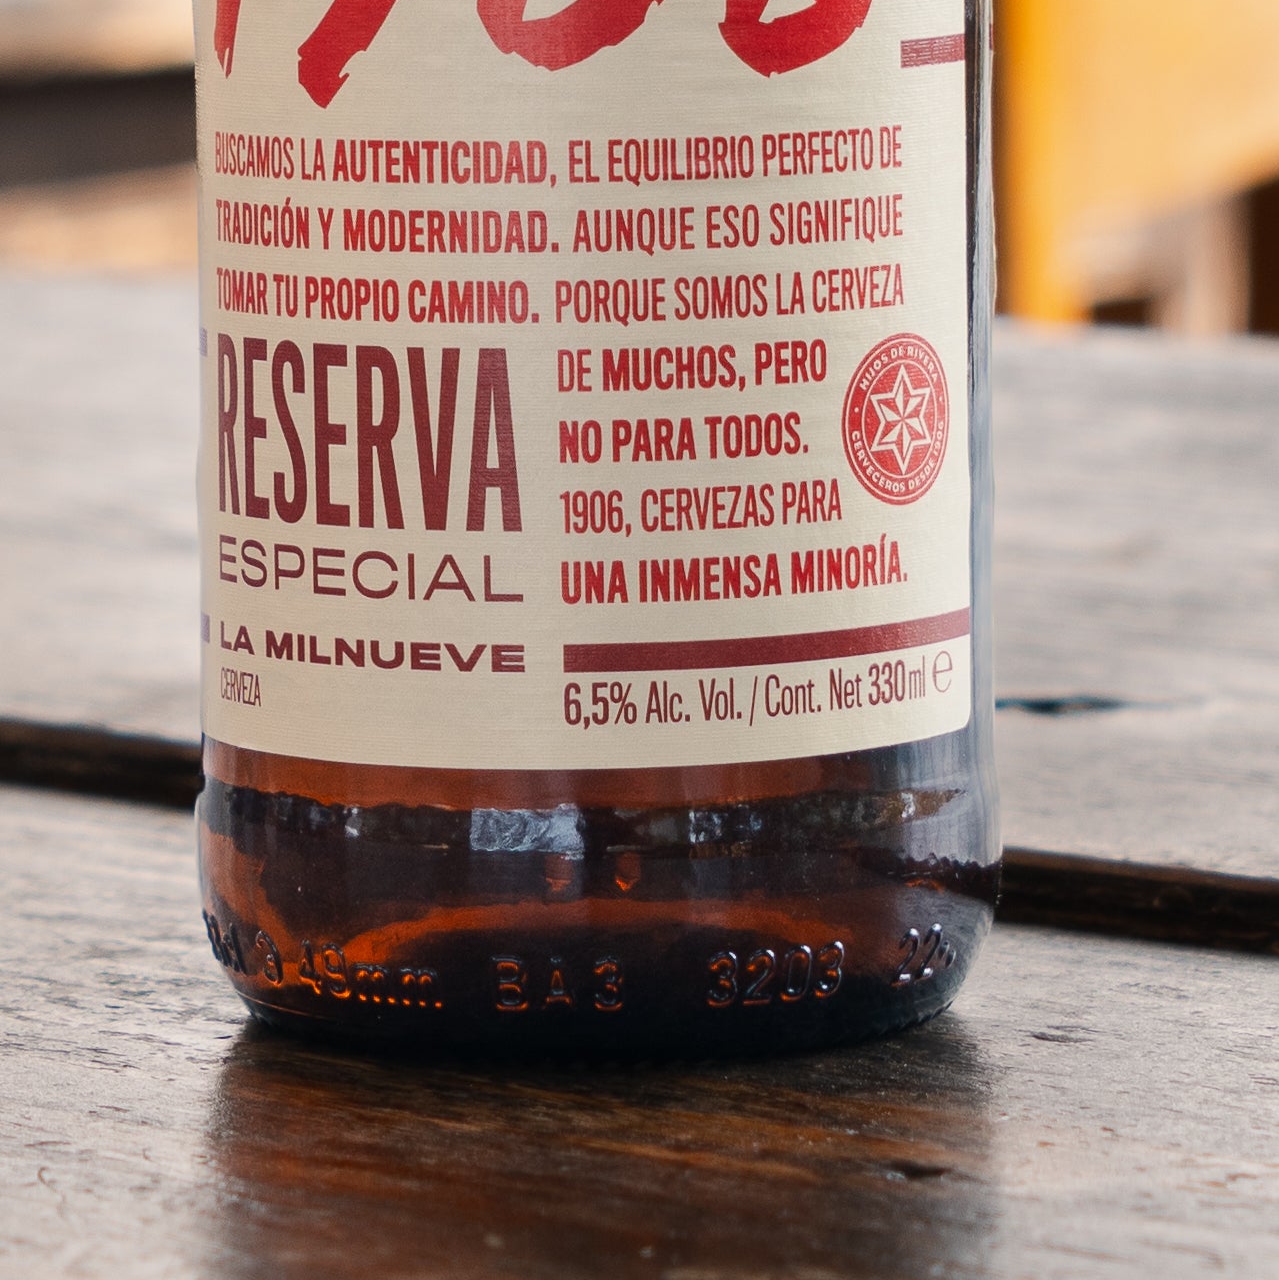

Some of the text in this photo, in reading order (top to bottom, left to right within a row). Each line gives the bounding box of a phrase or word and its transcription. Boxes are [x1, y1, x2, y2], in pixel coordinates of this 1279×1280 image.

[215, 125, 903, 186] BUSCAMOS LA AUTENTICIDAD, EL EQUILIBRIO PERFECTO DE
[216, 194, 903, 256] TRADICIÓN Y MODERNIDAD. AUNQUE ESO SIGNIFIQUE
[217, 264, 903, 327] TOMAR TU PROPIO CAMINO. PORQUE SOMOS LA CERVEZA
[557, 339, 827, 393] DE MUCHOS, PERO
[859, 353, 889, 391] HIJOS
[218, 332, 523, 531] RESERVA
[559, 411, 809, 464] NO PARA TODOS.
[851, 430, 905, 492] CERVECEROS
[908, 461, 935, 491] DESDE
[560, 478, 842, 536] 1906, CERVEZAS PARA
[220, 535, 524, 603] ESPECIAL
[561, 533, 907, 604] UNA INMENSA MINORÍA.
[220, 620, 525, 673] LA MILNUEVE
[220, 666, 263, 707] CERVEZA
[563, 681, 638, 730] 6,5%
[645, 680, 691, 724] Alc.
[697, 677, 744, 722] Vol.
[764, 673, 823, 718] Cont.
[828, 668, 862, 710] Net
